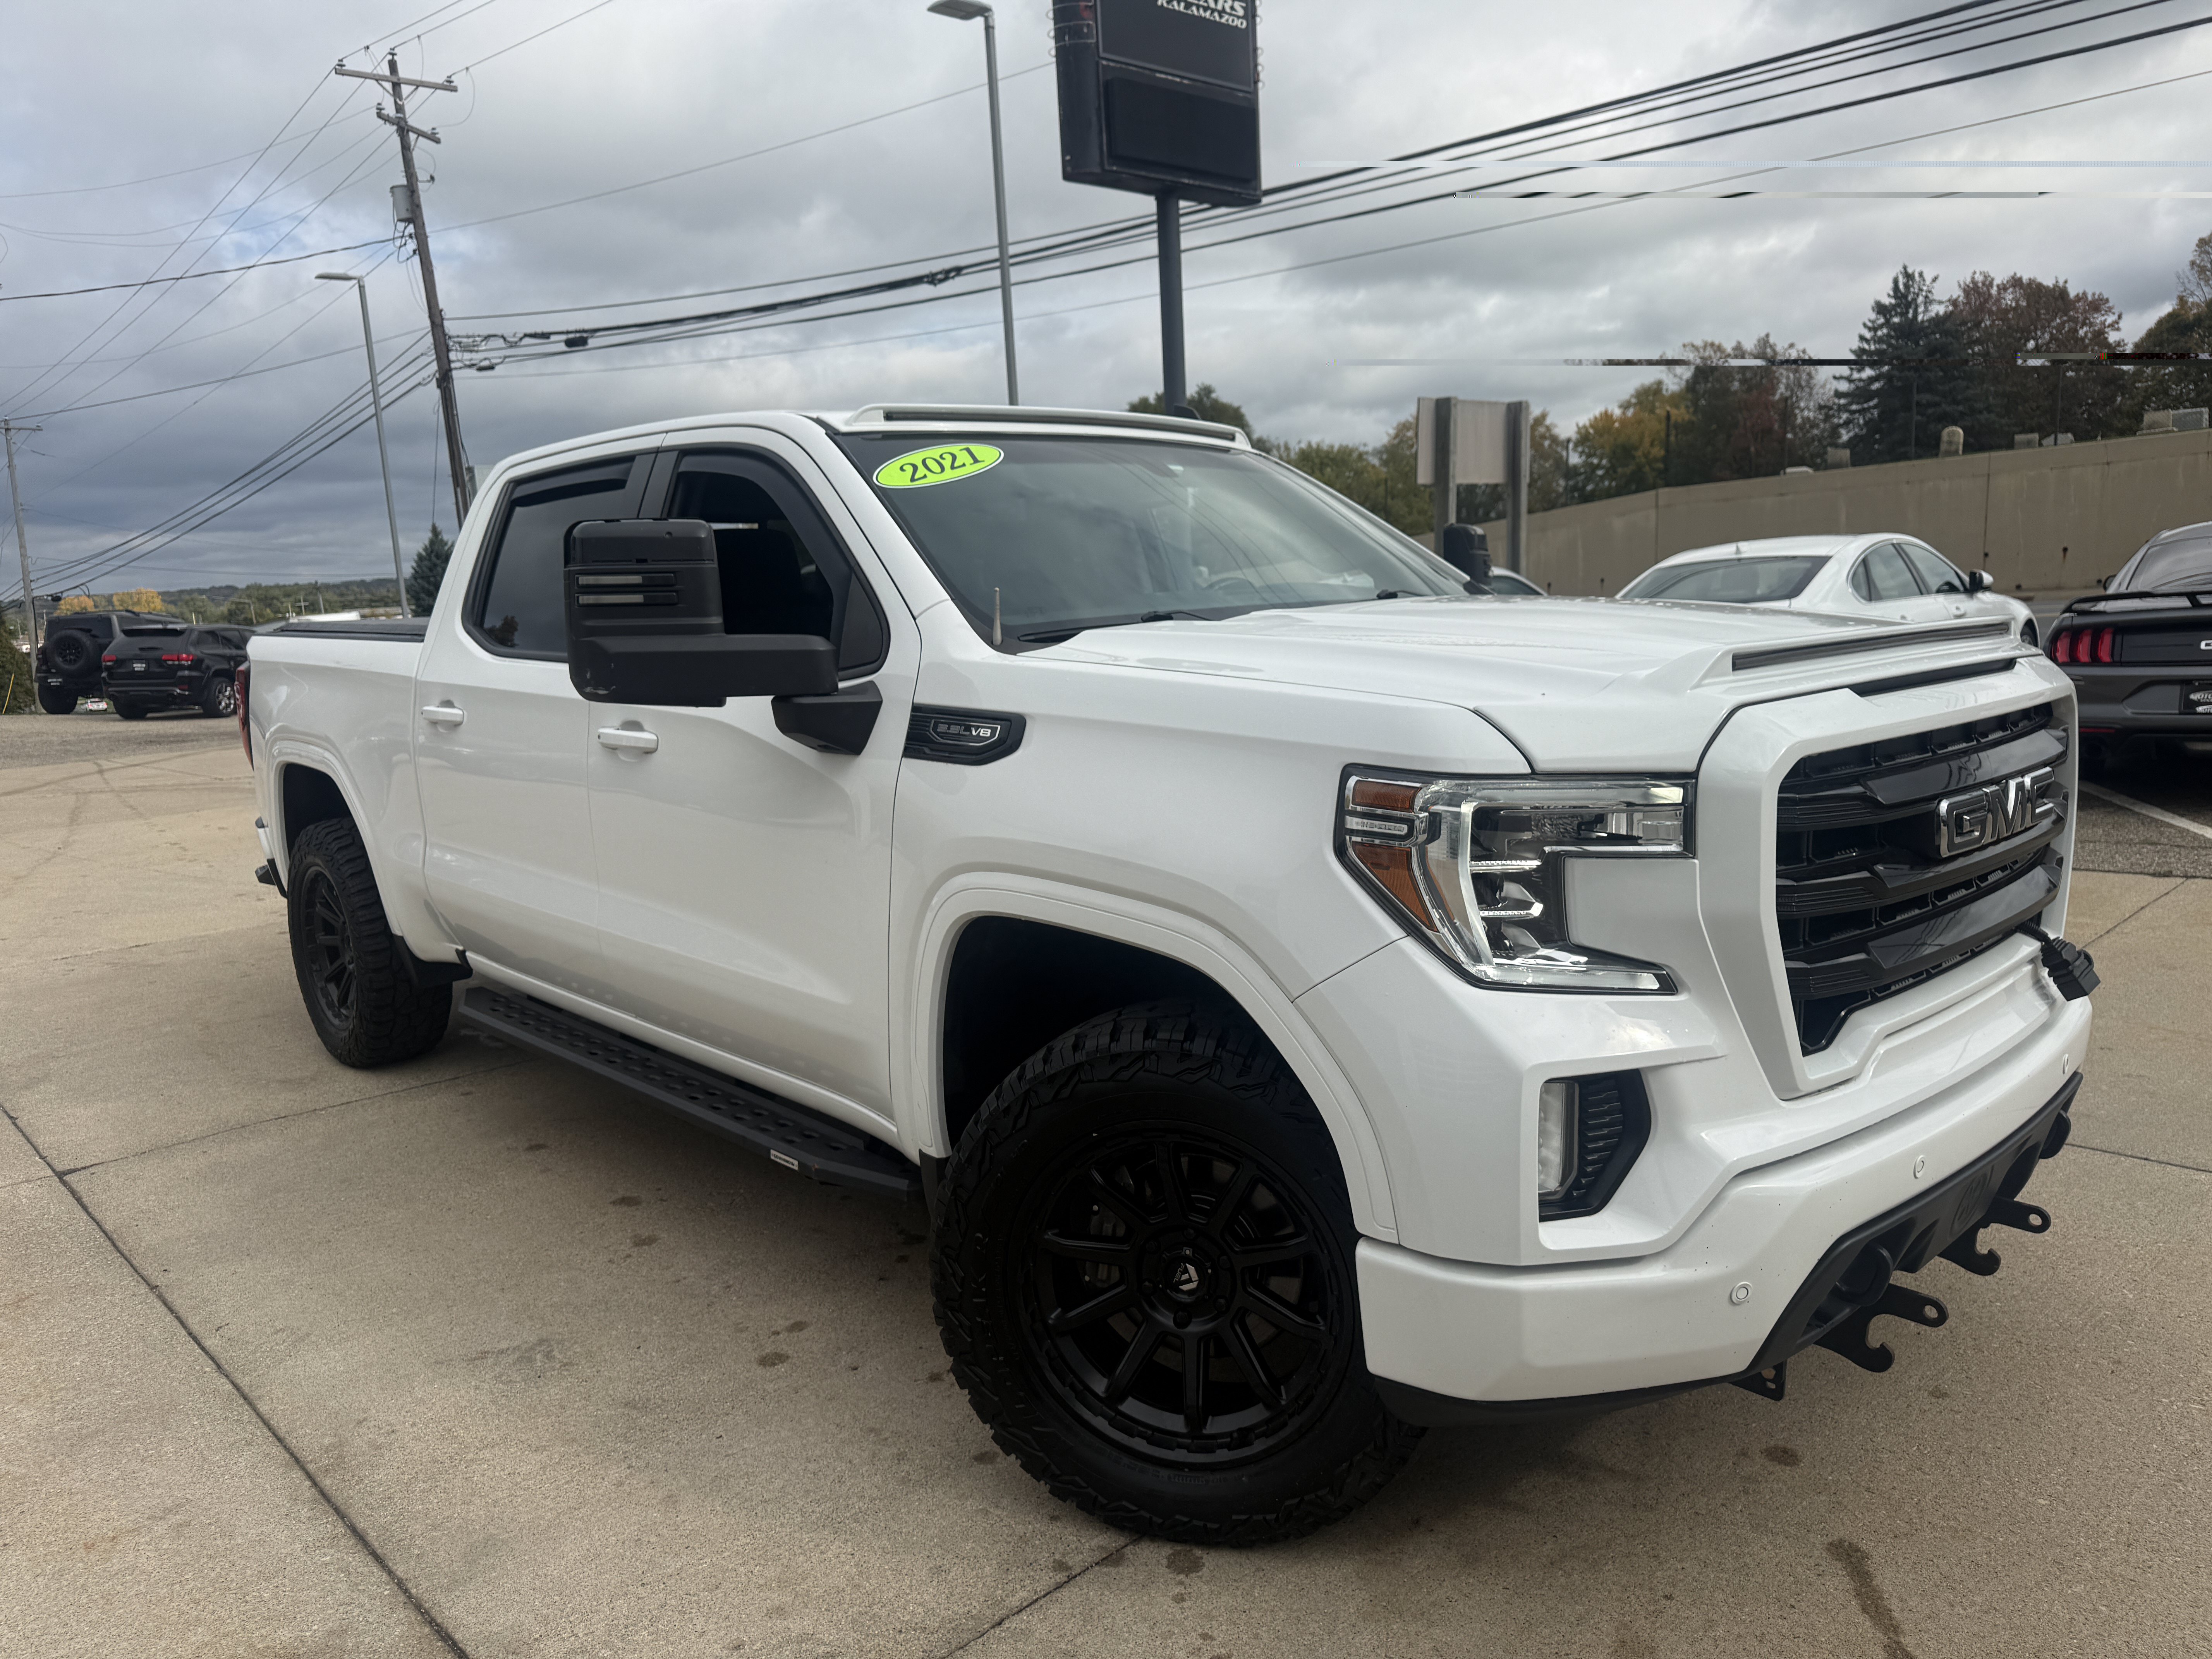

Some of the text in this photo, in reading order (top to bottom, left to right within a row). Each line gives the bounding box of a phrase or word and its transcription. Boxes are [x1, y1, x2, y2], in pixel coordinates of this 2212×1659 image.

[1157, 0, 1247, 29] KALAMAZOO
[899, 447, 985, 483] 2021
[971, 727, 991, 737] V8
[1936, 767, 2054, 858] GMC
